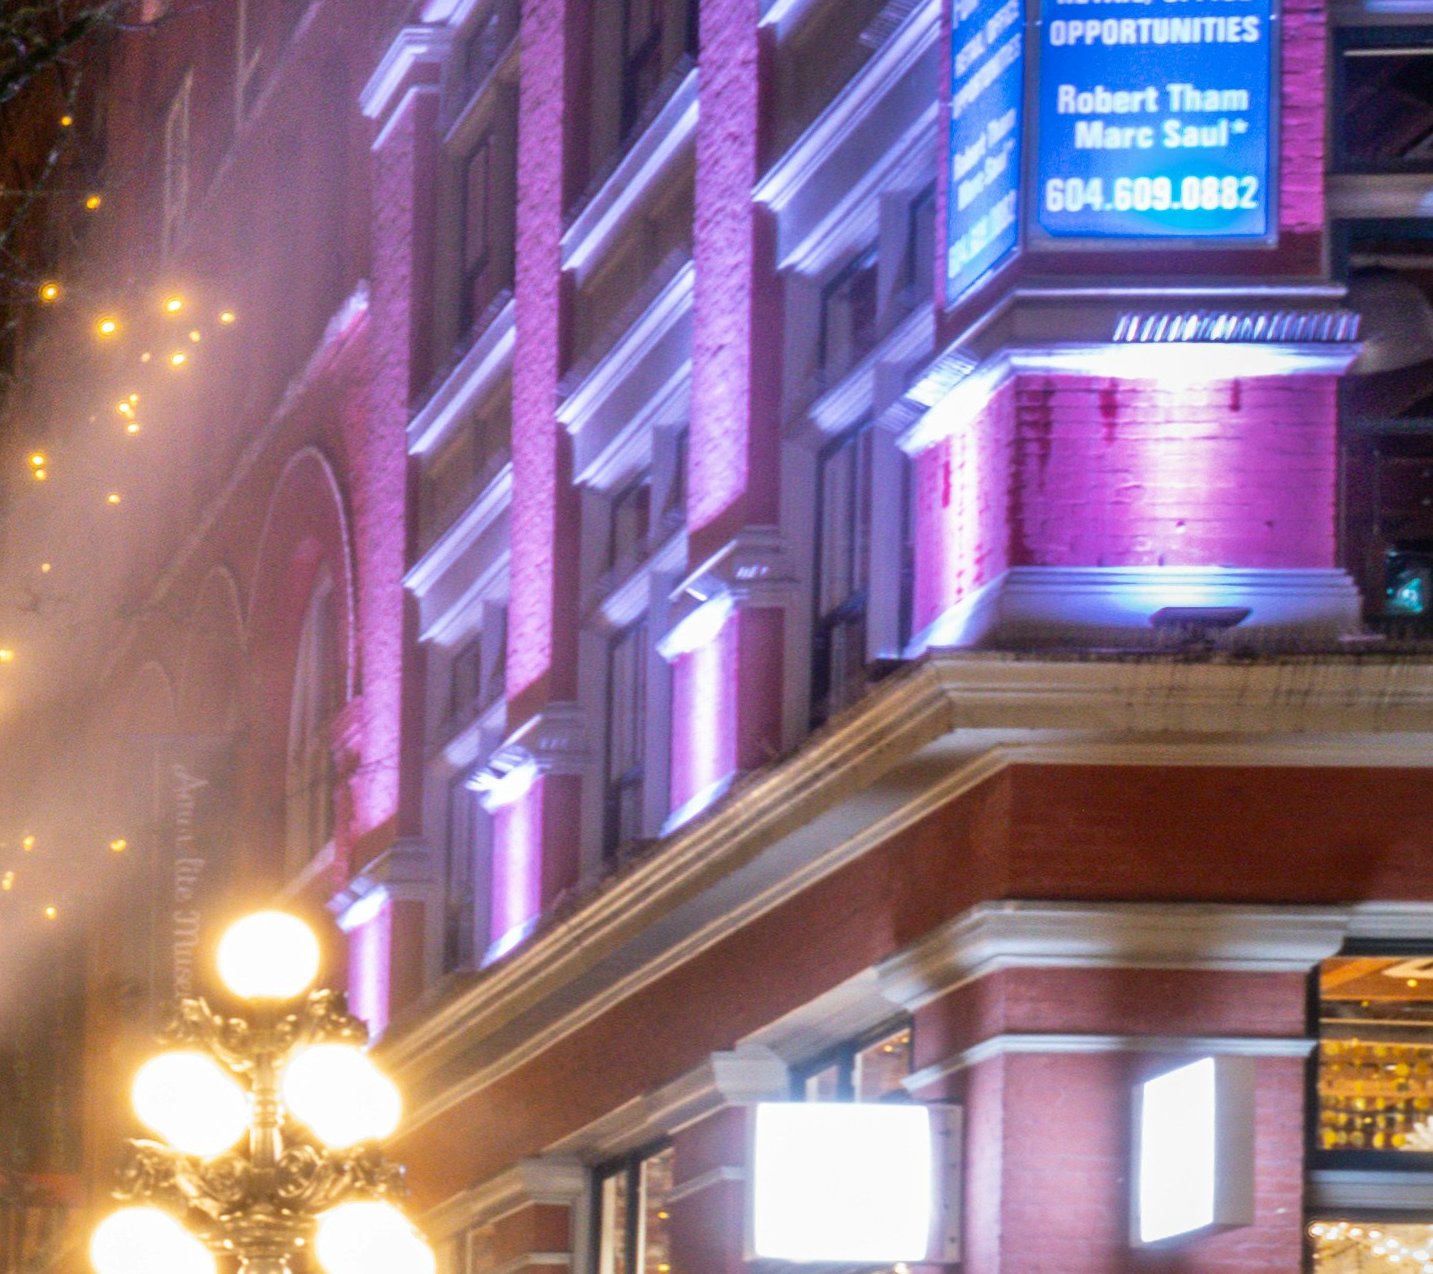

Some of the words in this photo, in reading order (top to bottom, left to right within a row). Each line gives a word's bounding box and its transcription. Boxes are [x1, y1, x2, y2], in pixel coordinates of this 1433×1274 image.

[1049, 15, 1261, 46] OPPORTUNITIES
[1057, 84, 1159, 115] Robert
[1166, 82, 1249, 112] Tham
[1074, 120, 1154, 150] Marc
[1045, 175, 1259, 213] 604.609.0882
